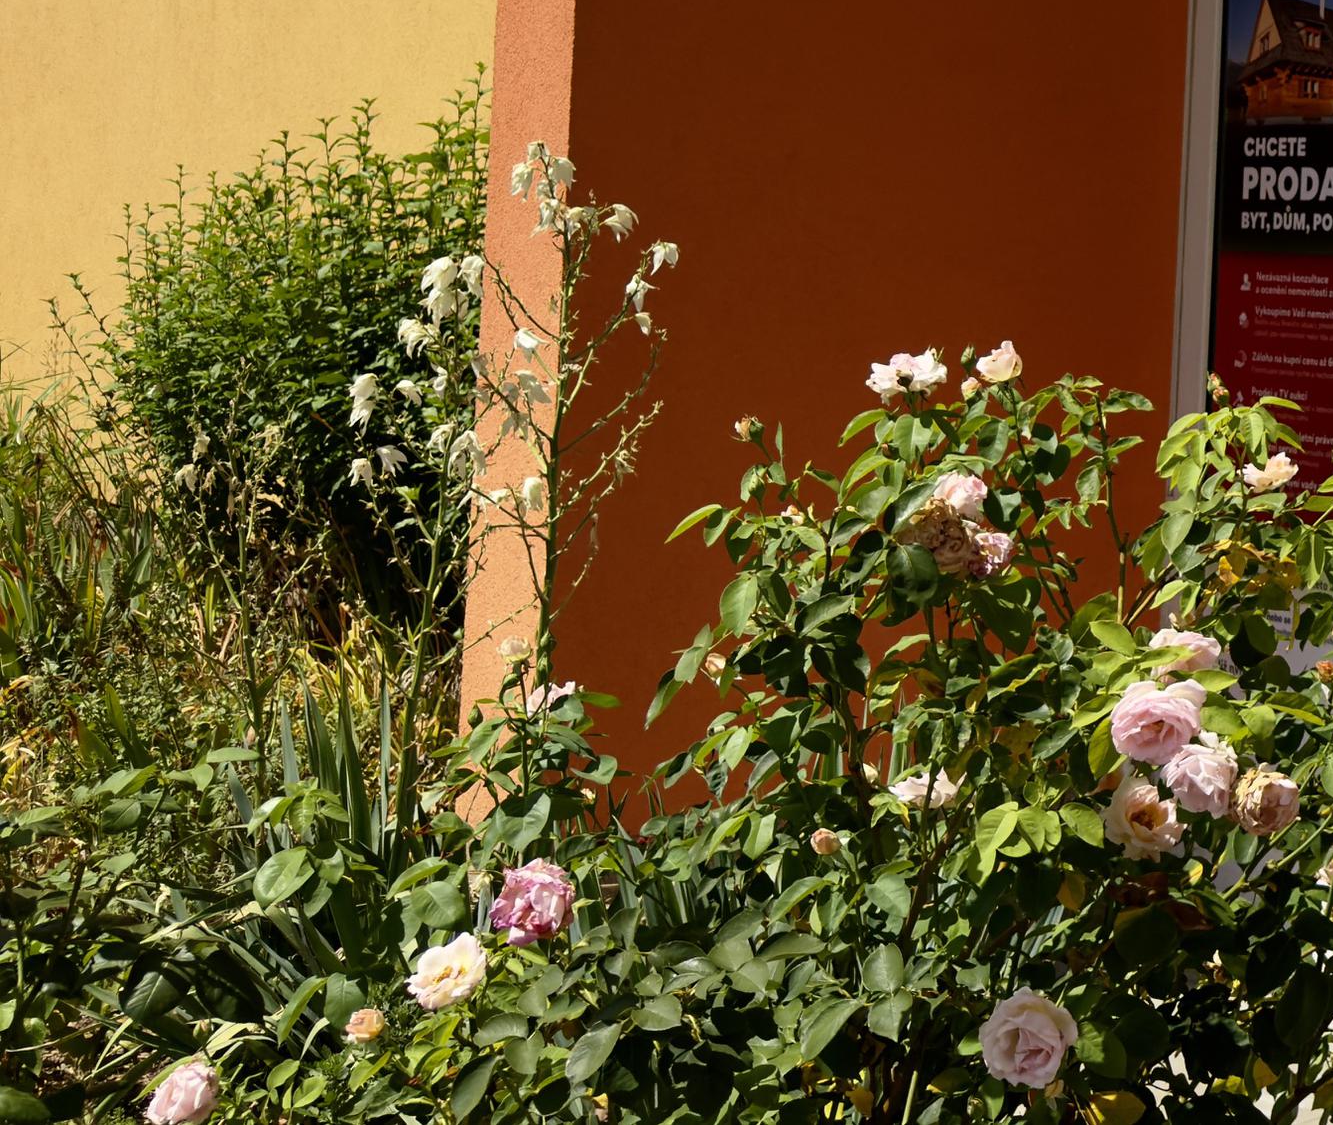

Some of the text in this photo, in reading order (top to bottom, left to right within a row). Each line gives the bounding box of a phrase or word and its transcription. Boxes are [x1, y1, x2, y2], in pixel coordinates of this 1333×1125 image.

[1244, 137, 1307, 157] CHCETE
[1241, 211, 1271, 233] BYT,
[1273, 205, 1311, 234] DŮM,
[1292, 274, 1329, 285] konzultace
[1260, 284, 1286, 296] ocenění
[1283, 352, 1301, 367] kupní
